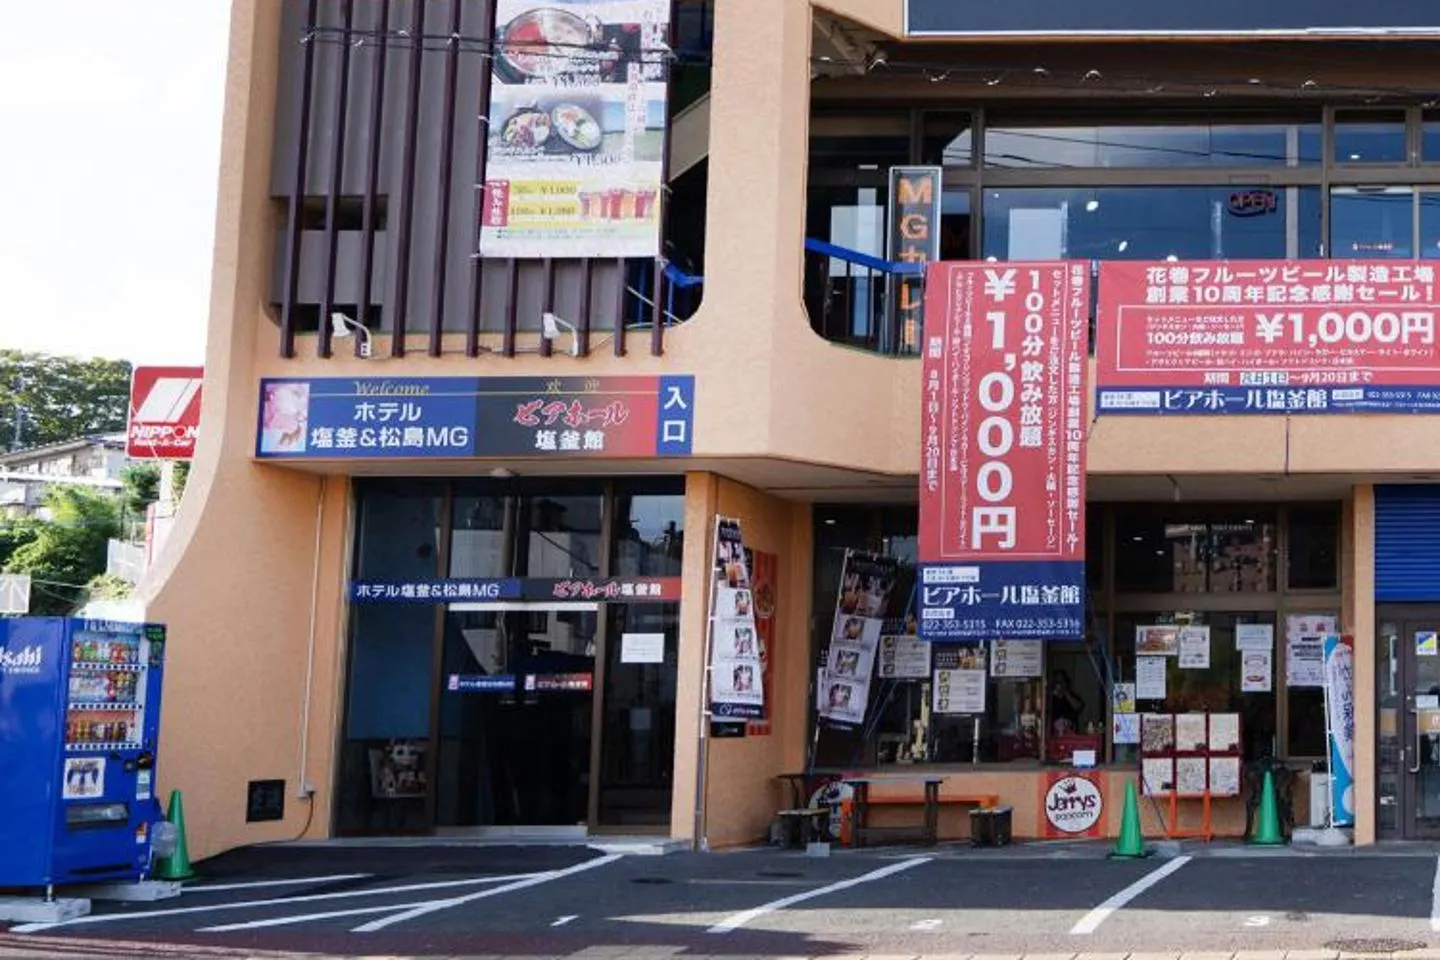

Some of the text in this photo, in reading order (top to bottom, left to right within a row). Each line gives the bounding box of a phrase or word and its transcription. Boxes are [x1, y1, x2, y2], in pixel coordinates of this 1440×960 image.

[1146, 331, 1245, 345] 100分飲み放題
[1255, 312, 1435, 348] ¥1,000円
[1019, 269, 1044, 448] 100分飲み放題
[353, 380, 430, 396] Welcome
[970, 268, 1018, 551] ¥1,000円
[1163, 389, 1328, 410] ビアホール塩釜館
[353, 401, 423, 422] ホテル
[513, 398, 631, 428] ビアホール
[663, 385, 687, 443] 入口
[129, 425, 200, 439] NIPPON
[310, 426, 469, 449] 塩釜&松島MG
[535, 429, 605, 451] 塩釜館
[922, 585, 1081, 606] ビアホール塩釜館
[0, 644, 42, 667] sahi
